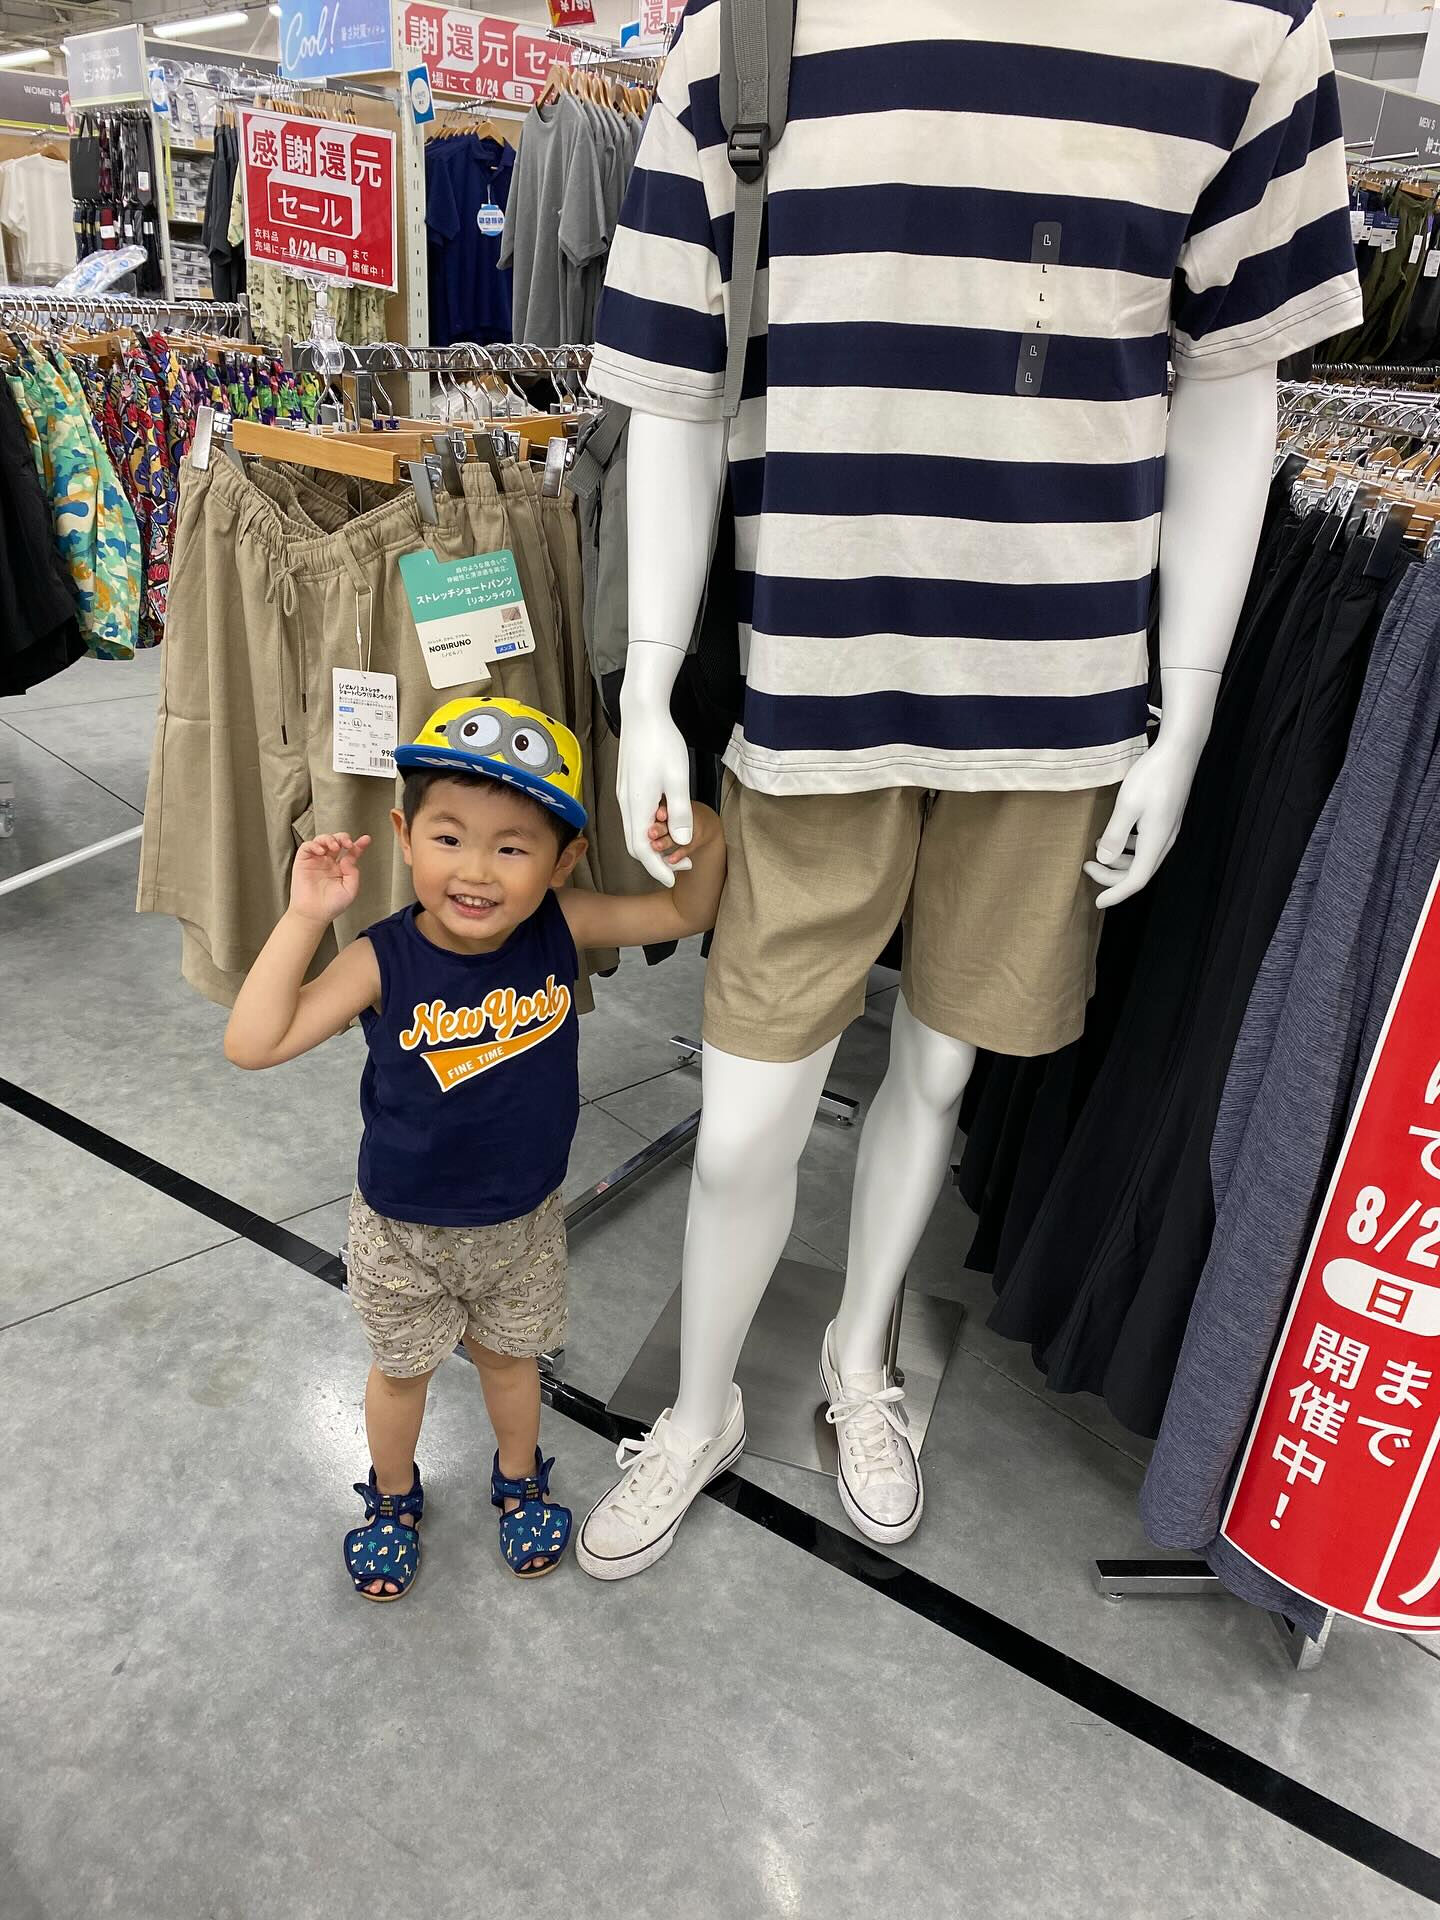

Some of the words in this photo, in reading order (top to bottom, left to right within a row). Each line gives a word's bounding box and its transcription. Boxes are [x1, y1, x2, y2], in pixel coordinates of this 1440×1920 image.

[285, 1, 340, 71] Cool!
[408, 15, 509, 68] 謝還元
[251, 129, 383, 188] 感謝還元
[277, 189, 343, 228] セール
[254, 228, 279, 242] 衣料品
[1043, 234, 1051, 245] L
[288, 237, 318, 260] 8/24
[352, 249, 369, 261] まで
[1042, 264, 1047, 273] L
[1039, 293, 1044, 301] L
[1029, 345, 1037, 356] L
[1025, 372, 1033, 383] L
[416, 576, 513, 605] ストレッチショートパンツ
[428, 638, 472, 653] NOBIRUNO
[517, 640, 529, 650] LL
[447, 1061, 474, 1079] FINE
[477, 1046, 505, 1065] TIME
[1366, 1279, 1414, 1324] 日
[1357, 1360, 1433, 1468] まで
